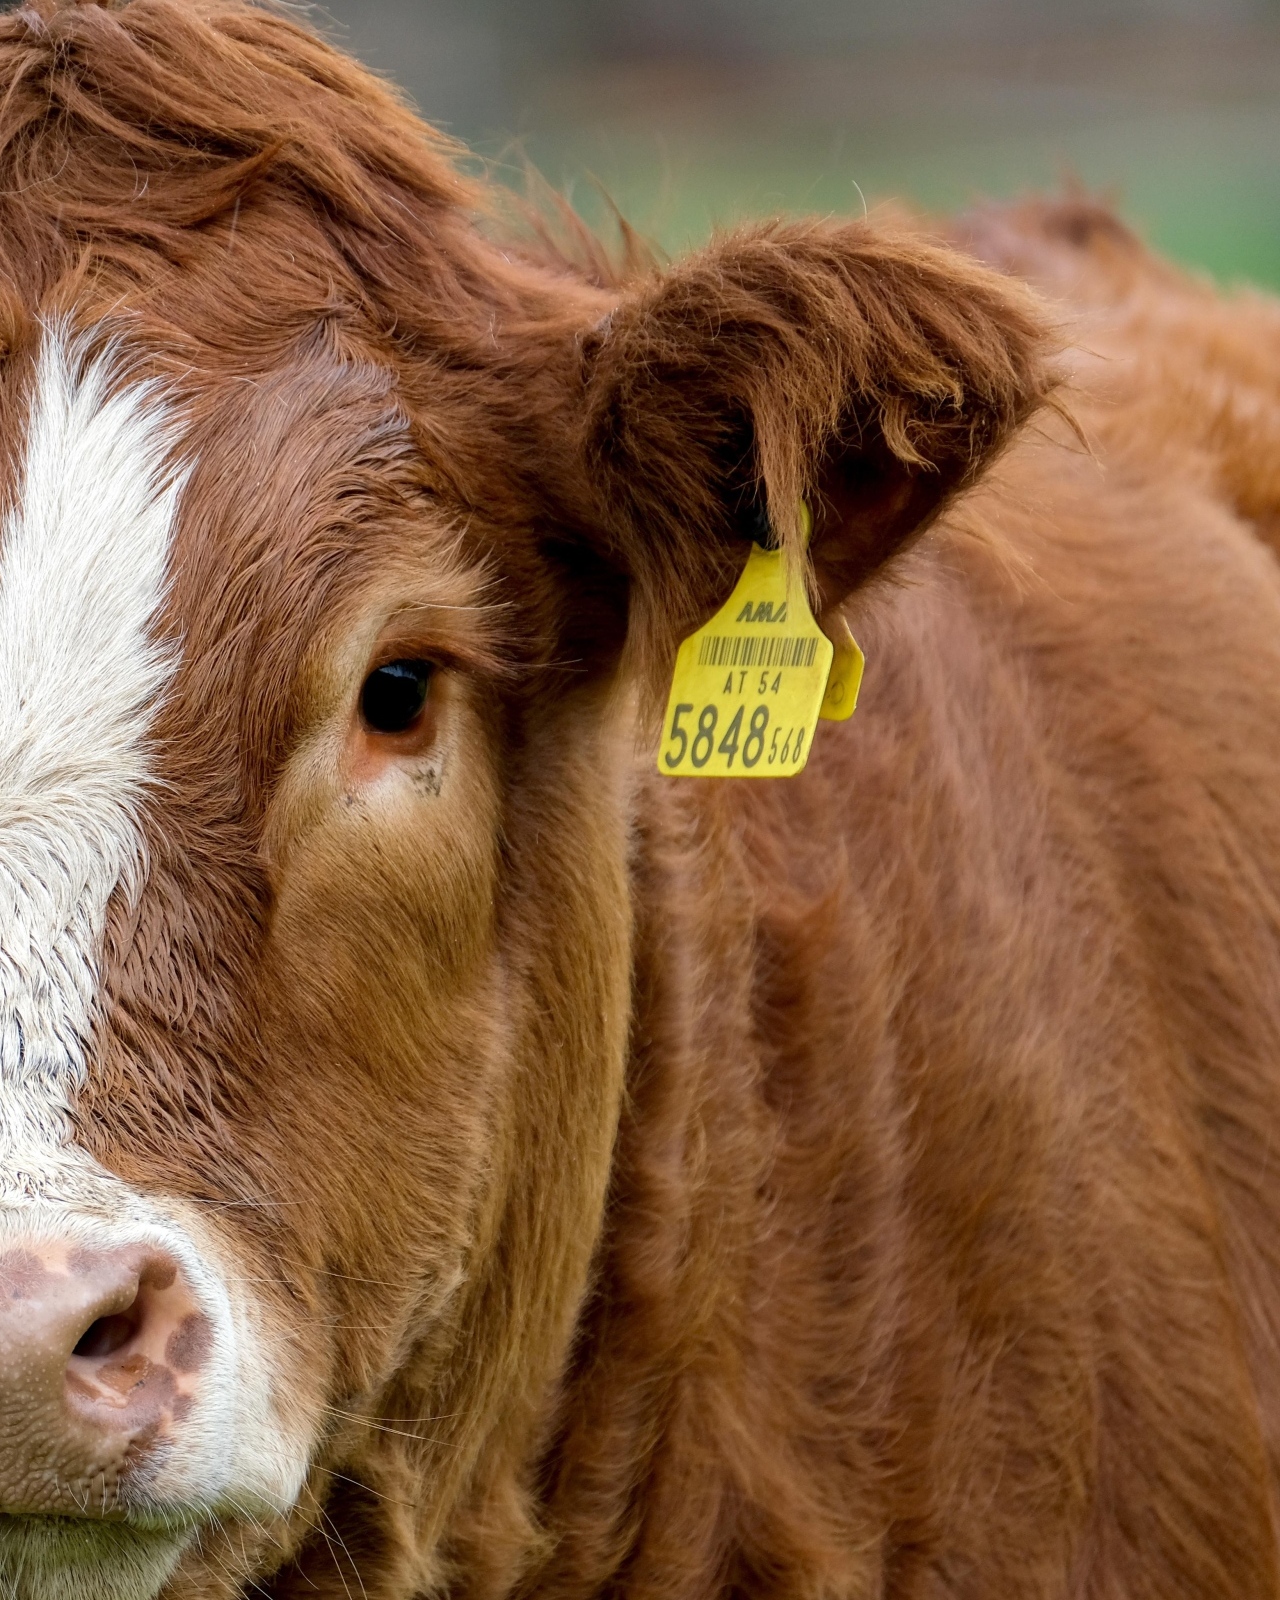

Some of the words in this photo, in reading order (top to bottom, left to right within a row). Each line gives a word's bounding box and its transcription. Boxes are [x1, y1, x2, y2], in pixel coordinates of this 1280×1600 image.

[736, 601, 787, 622] AMA
[723, 671, 748, 694] AT
[758, 671, 782, 694] 54
[665, 703, 769, 768] 5848
[768, 727, 805, 765] 568
